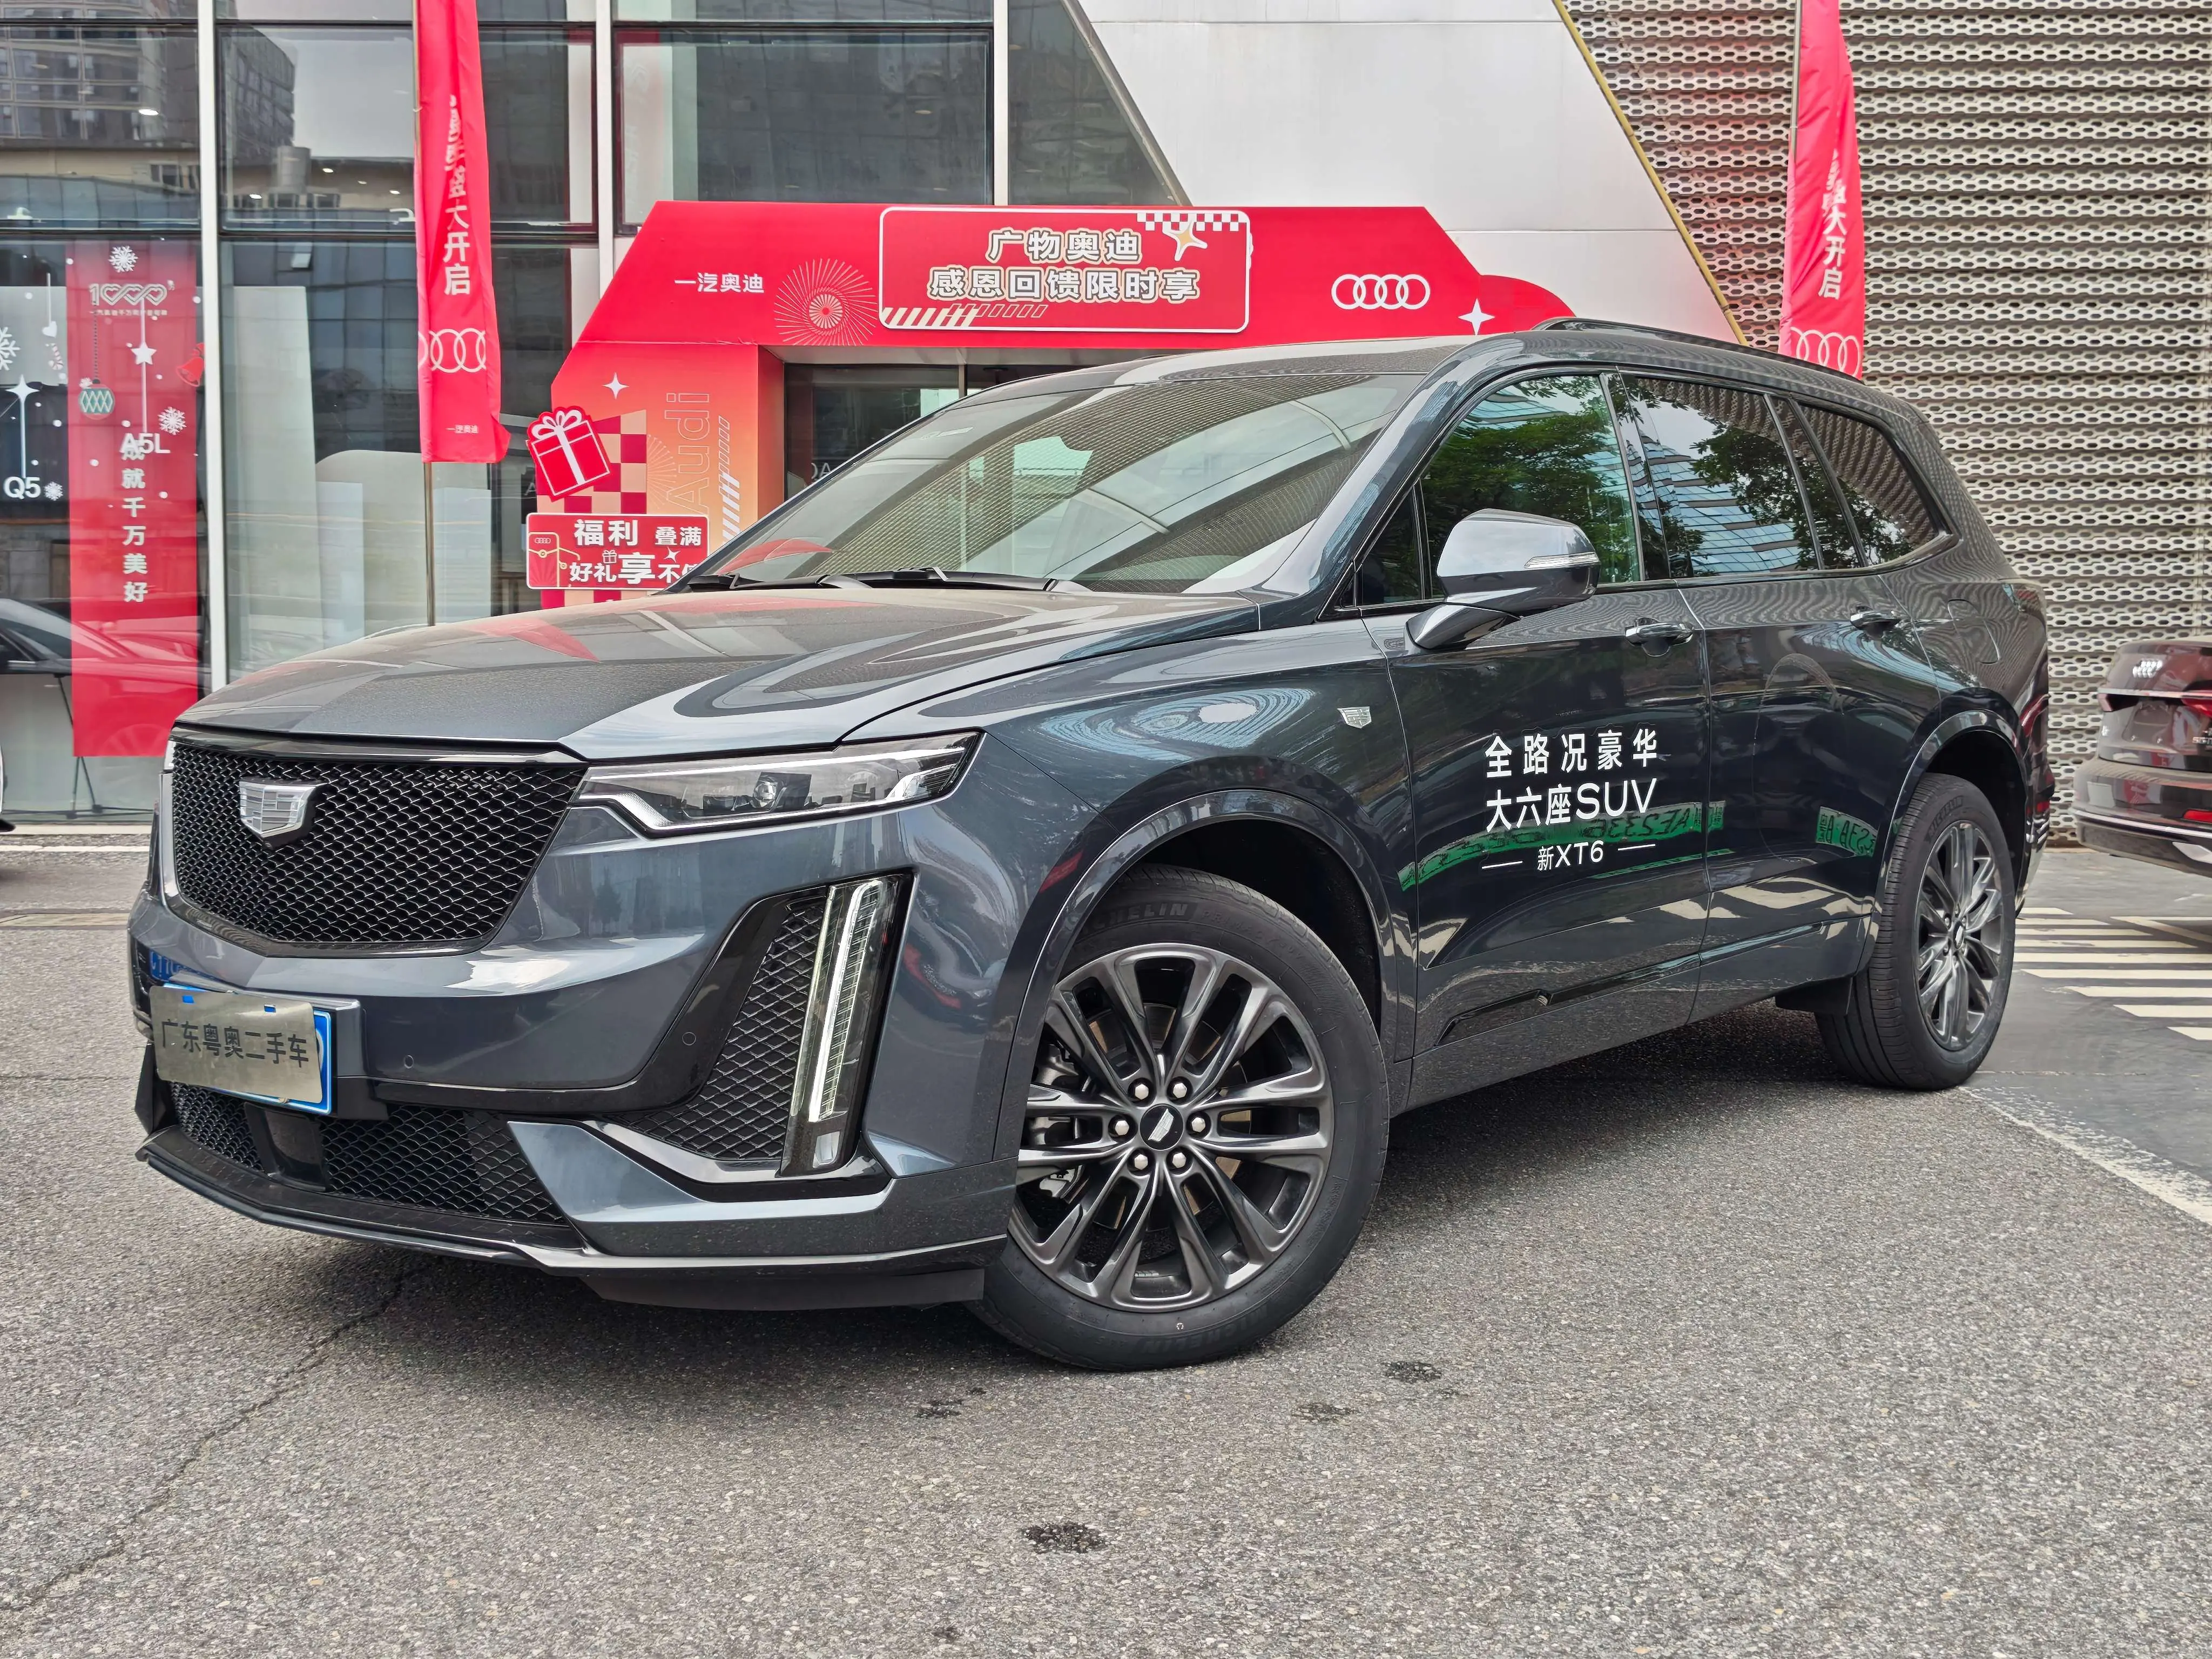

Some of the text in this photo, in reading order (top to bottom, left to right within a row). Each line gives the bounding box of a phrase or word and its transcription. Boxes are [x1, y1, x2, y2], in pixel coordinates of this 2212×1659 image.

[988, 229, 1142, 263] 广物奥迪
[674, 272, 765, 293] 一汽奥迪
[928, 265, 1200, 302] 感恩回馈限时享
[119, 433, 171, 454] A5L
[664, 393, 710, 515] Audi
[3, 476, 42, 500] Q5
[574, 518, 702, 547] 福利 叠满
[1484, 729, 1658, 779] 全路况豪华
[1485, 777, 1658, 833] 大六座SUV
[1536, 839, 1604, 872] 新XT6
[1085, 902, 1189, 932] CHELIN
[161, 1018, 309, 1068] 广东粤奥二手车
